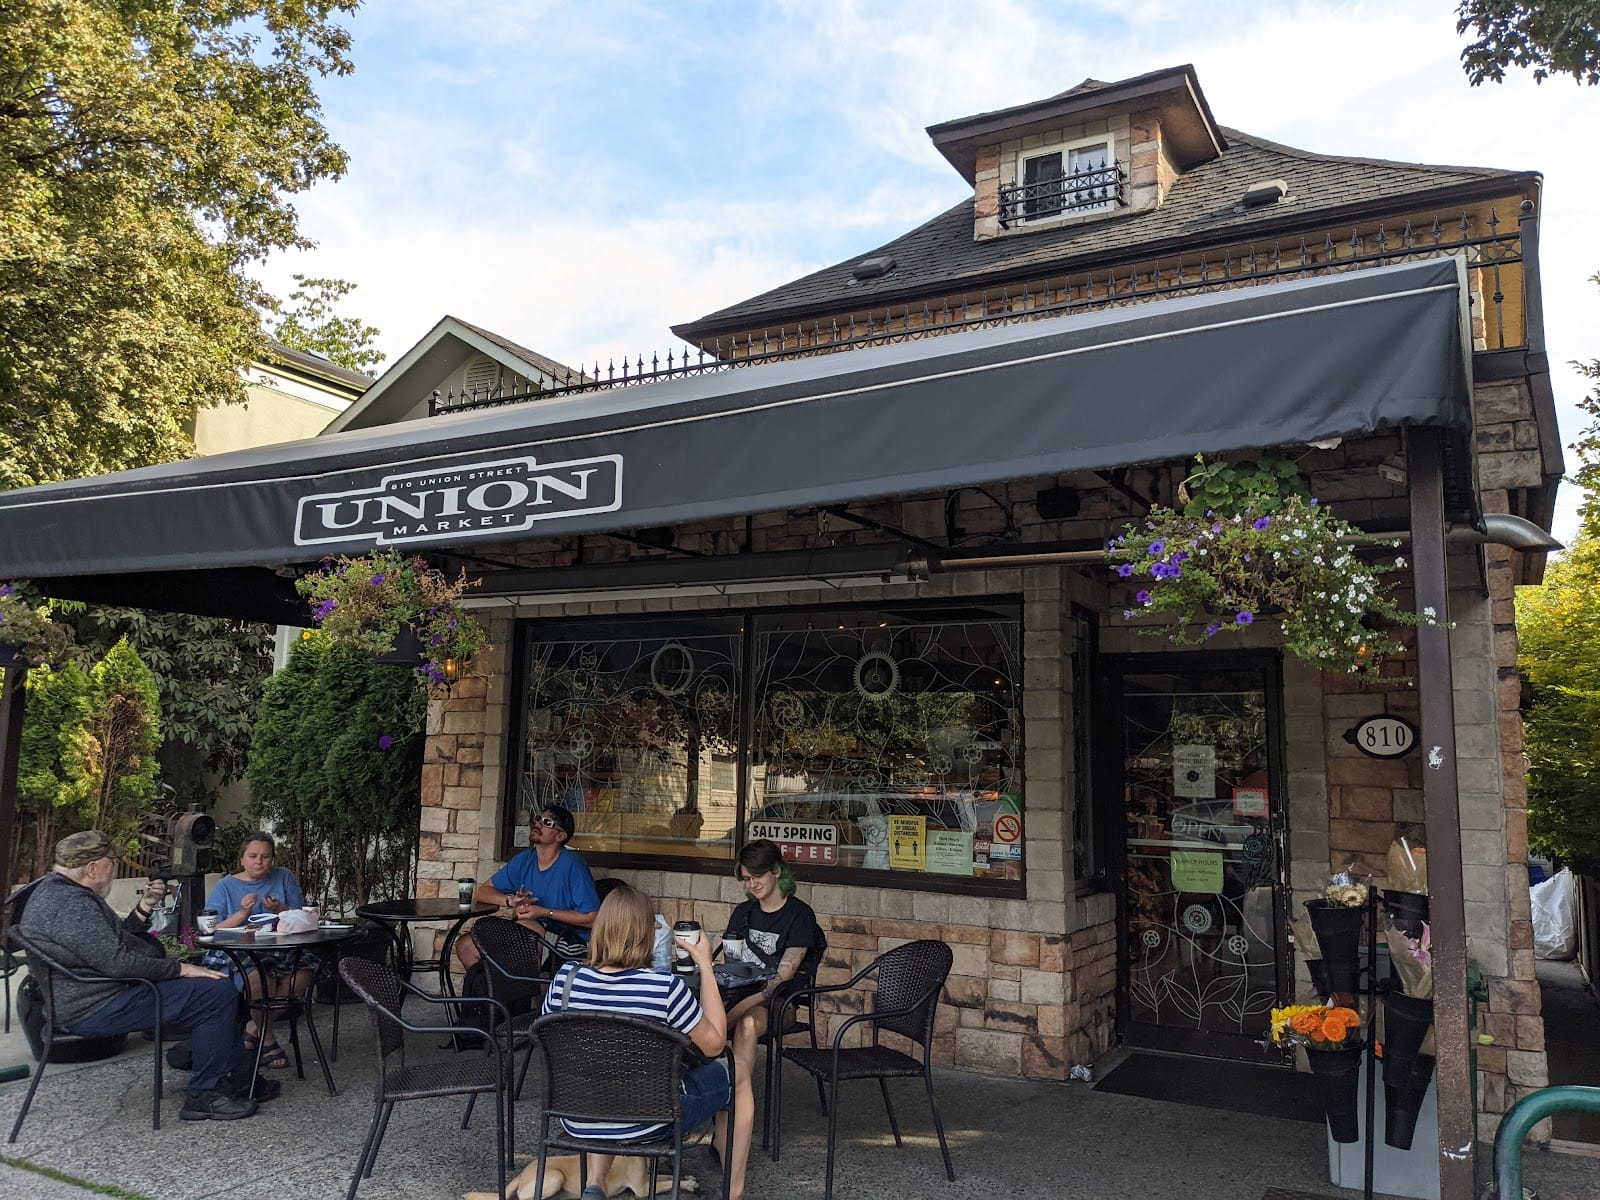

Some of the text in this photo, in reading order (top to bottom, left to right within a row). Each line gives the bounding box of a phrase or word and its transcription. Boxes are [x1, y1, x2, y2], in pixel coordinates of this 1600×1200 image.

[391, 467, 522, 490] 810 UNION STREET
[315, 468, 598, 529] UNION
[393, 513, 514, 535] MARKET
[1365, 725, 1406, 747] 810
[752, 825, 833, 841] SALT SPRING
[780, 844, 833, 860] FFEE
